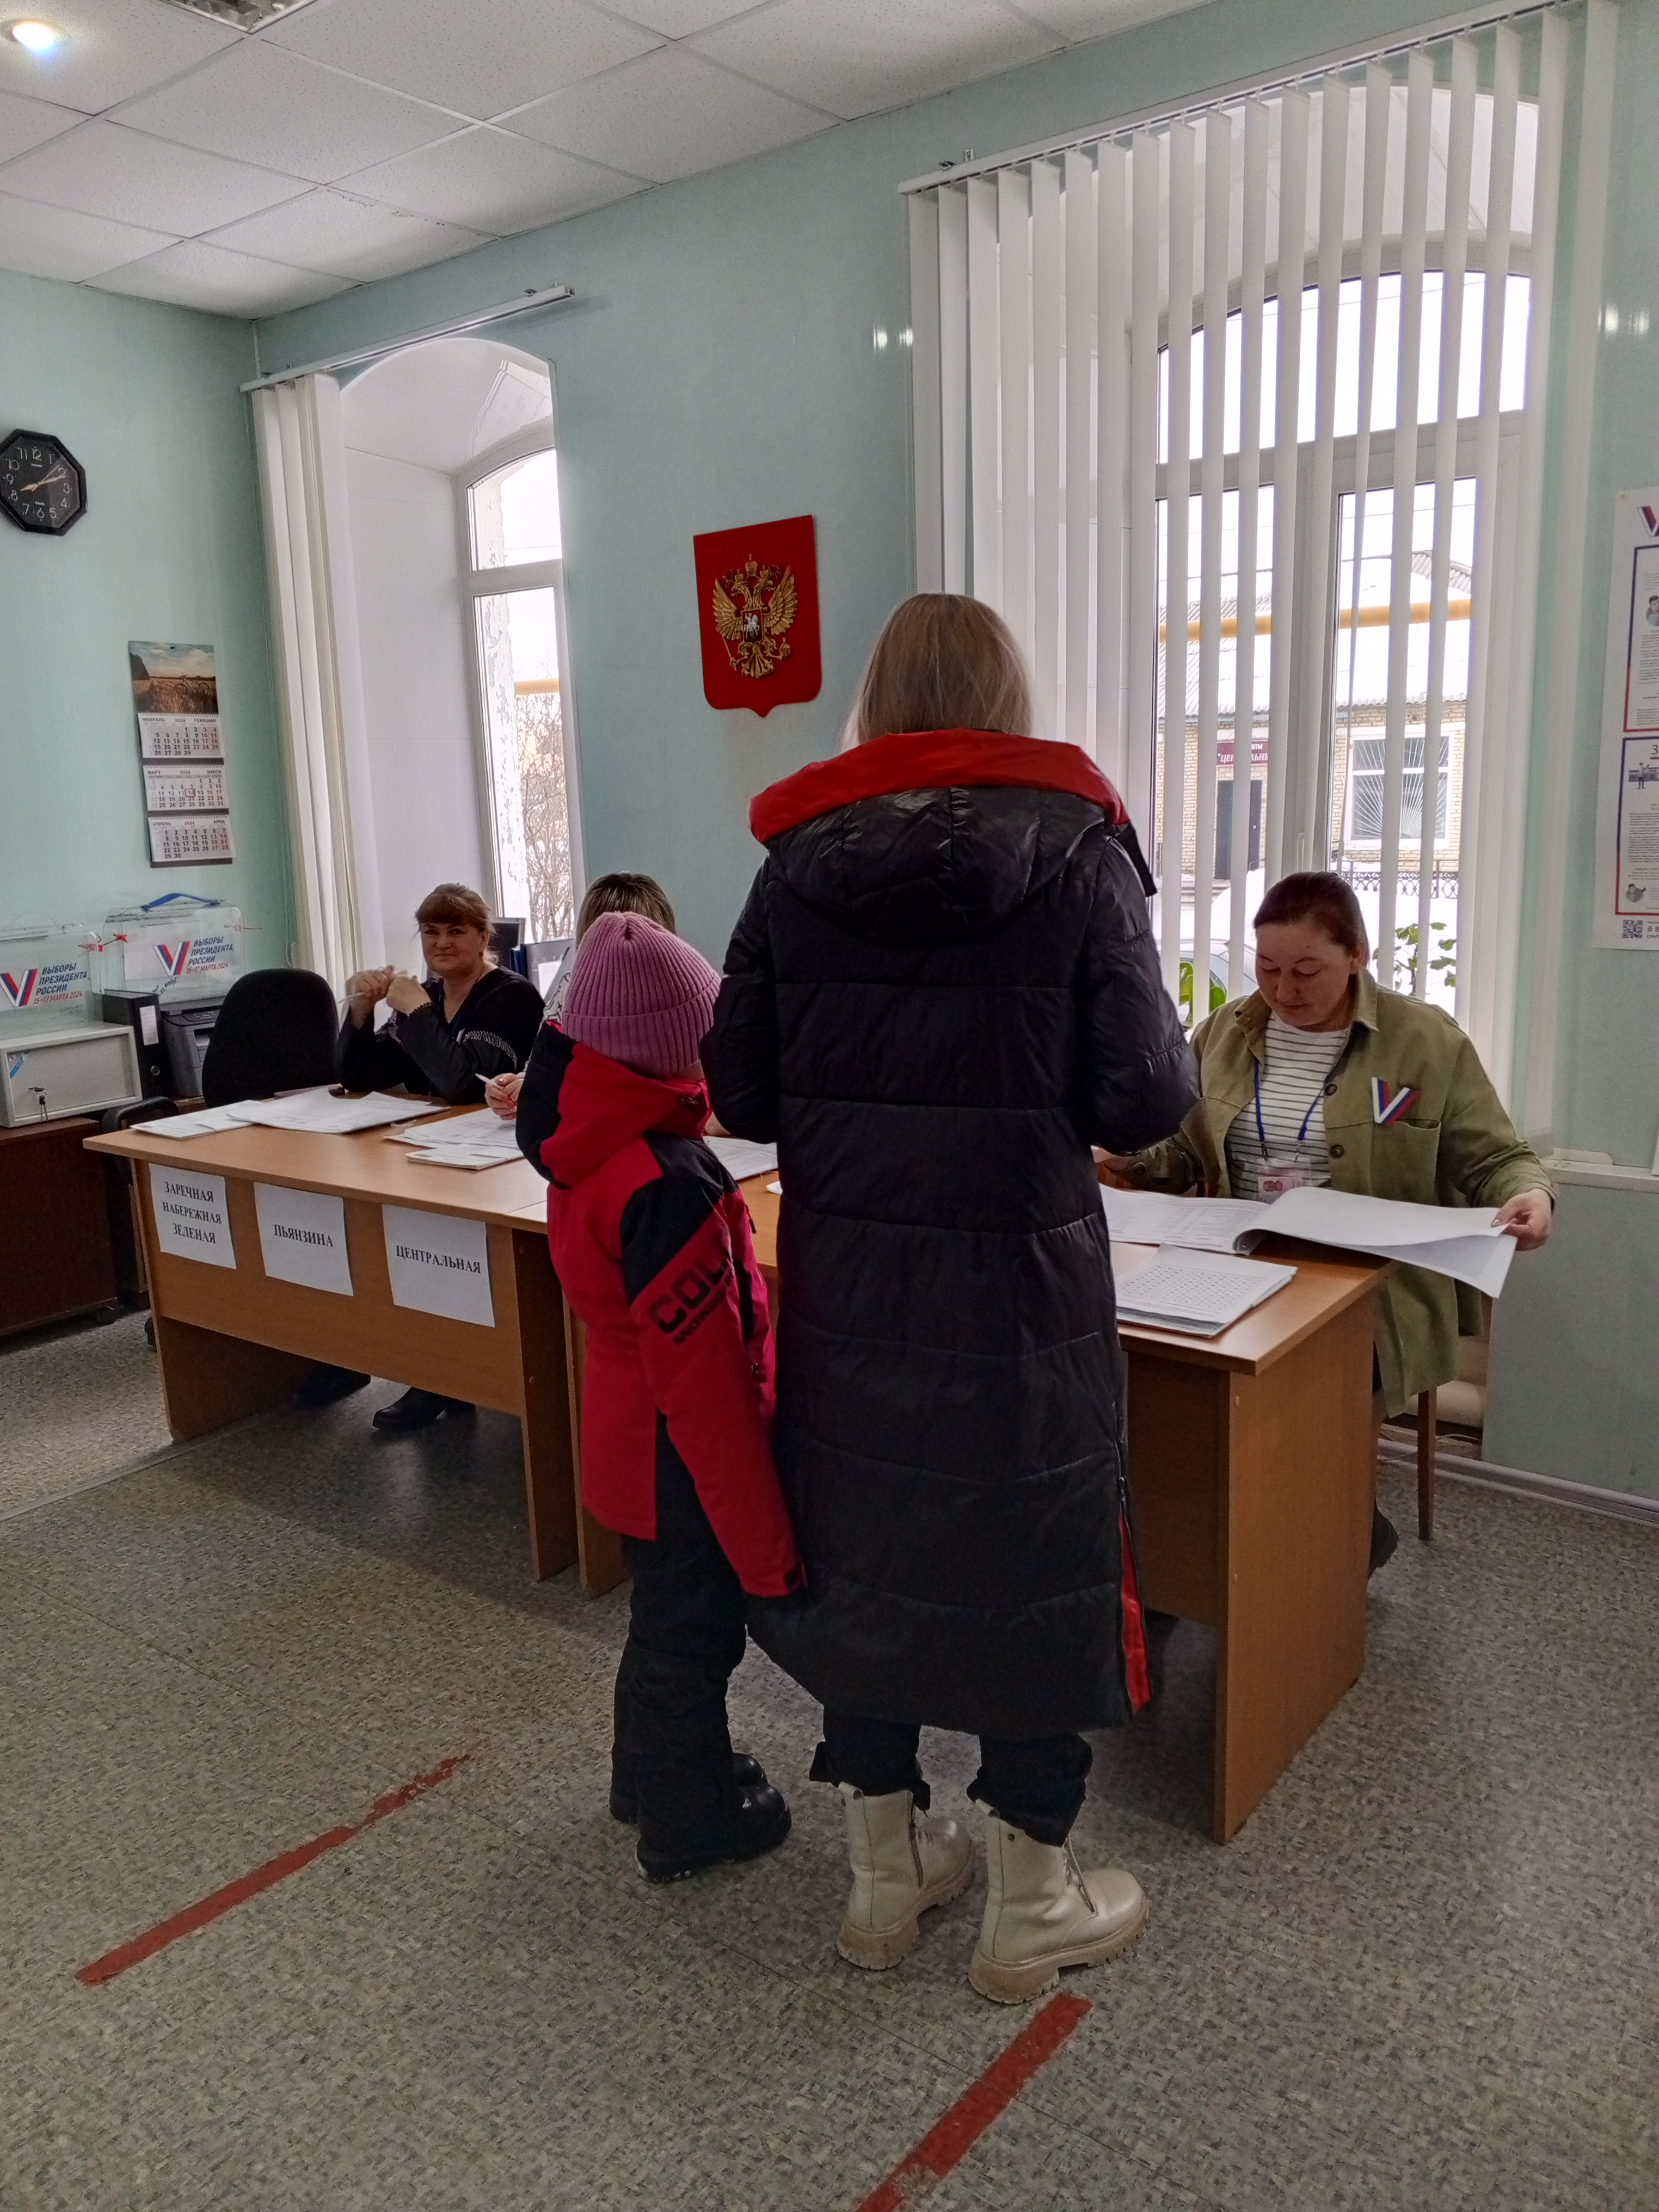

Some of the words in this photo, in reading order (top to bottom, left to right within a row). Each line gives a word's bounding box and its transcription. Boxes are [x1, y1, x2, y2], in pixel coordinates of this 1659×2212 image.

[20, 447, 27, 460] 11
[32, 448, 41, 460] 12
[7, 459, 20, 470] 10
[58, 468, 65, 478] 2
[6, 474, 14, 485] 9
[63, 483, 70, 494] 3
[11, 490, 18, 501] 8
[61, 497, 67, 508] 4
[22, 503, 29, 514] 7
[37, 508, 45, 518] 6
[50, 508, 57, 518] 5
[194, 936, 224, 947] ВЫБОРЫ
[191, 944, 233, 956] ПРЕЗИДЕНТА
[188, 956, 216, 966] РОССИИ
[42, 963, 76, 975] ВЫБОРЫ
[39, 971, 87, 985] ПРЕЗИДЕНТА
[36, 984, 67, 996] РОССИИ
[50, 993, 68, 1001] МАРТА
[164, 1181, 214, 1202] ЗАРЕЧНАЯ
[163, 1202, 222, 1225] НАБЕРЕЖНАЯ
[173, 1223, 216, 1244] ЗЕЛЕНАЯ
[273, 1224, 334, 1247] ПЬЯНЗИНА
[396, 1245, 481, 1274] ЦЕНТРАЛЬНАЯ
